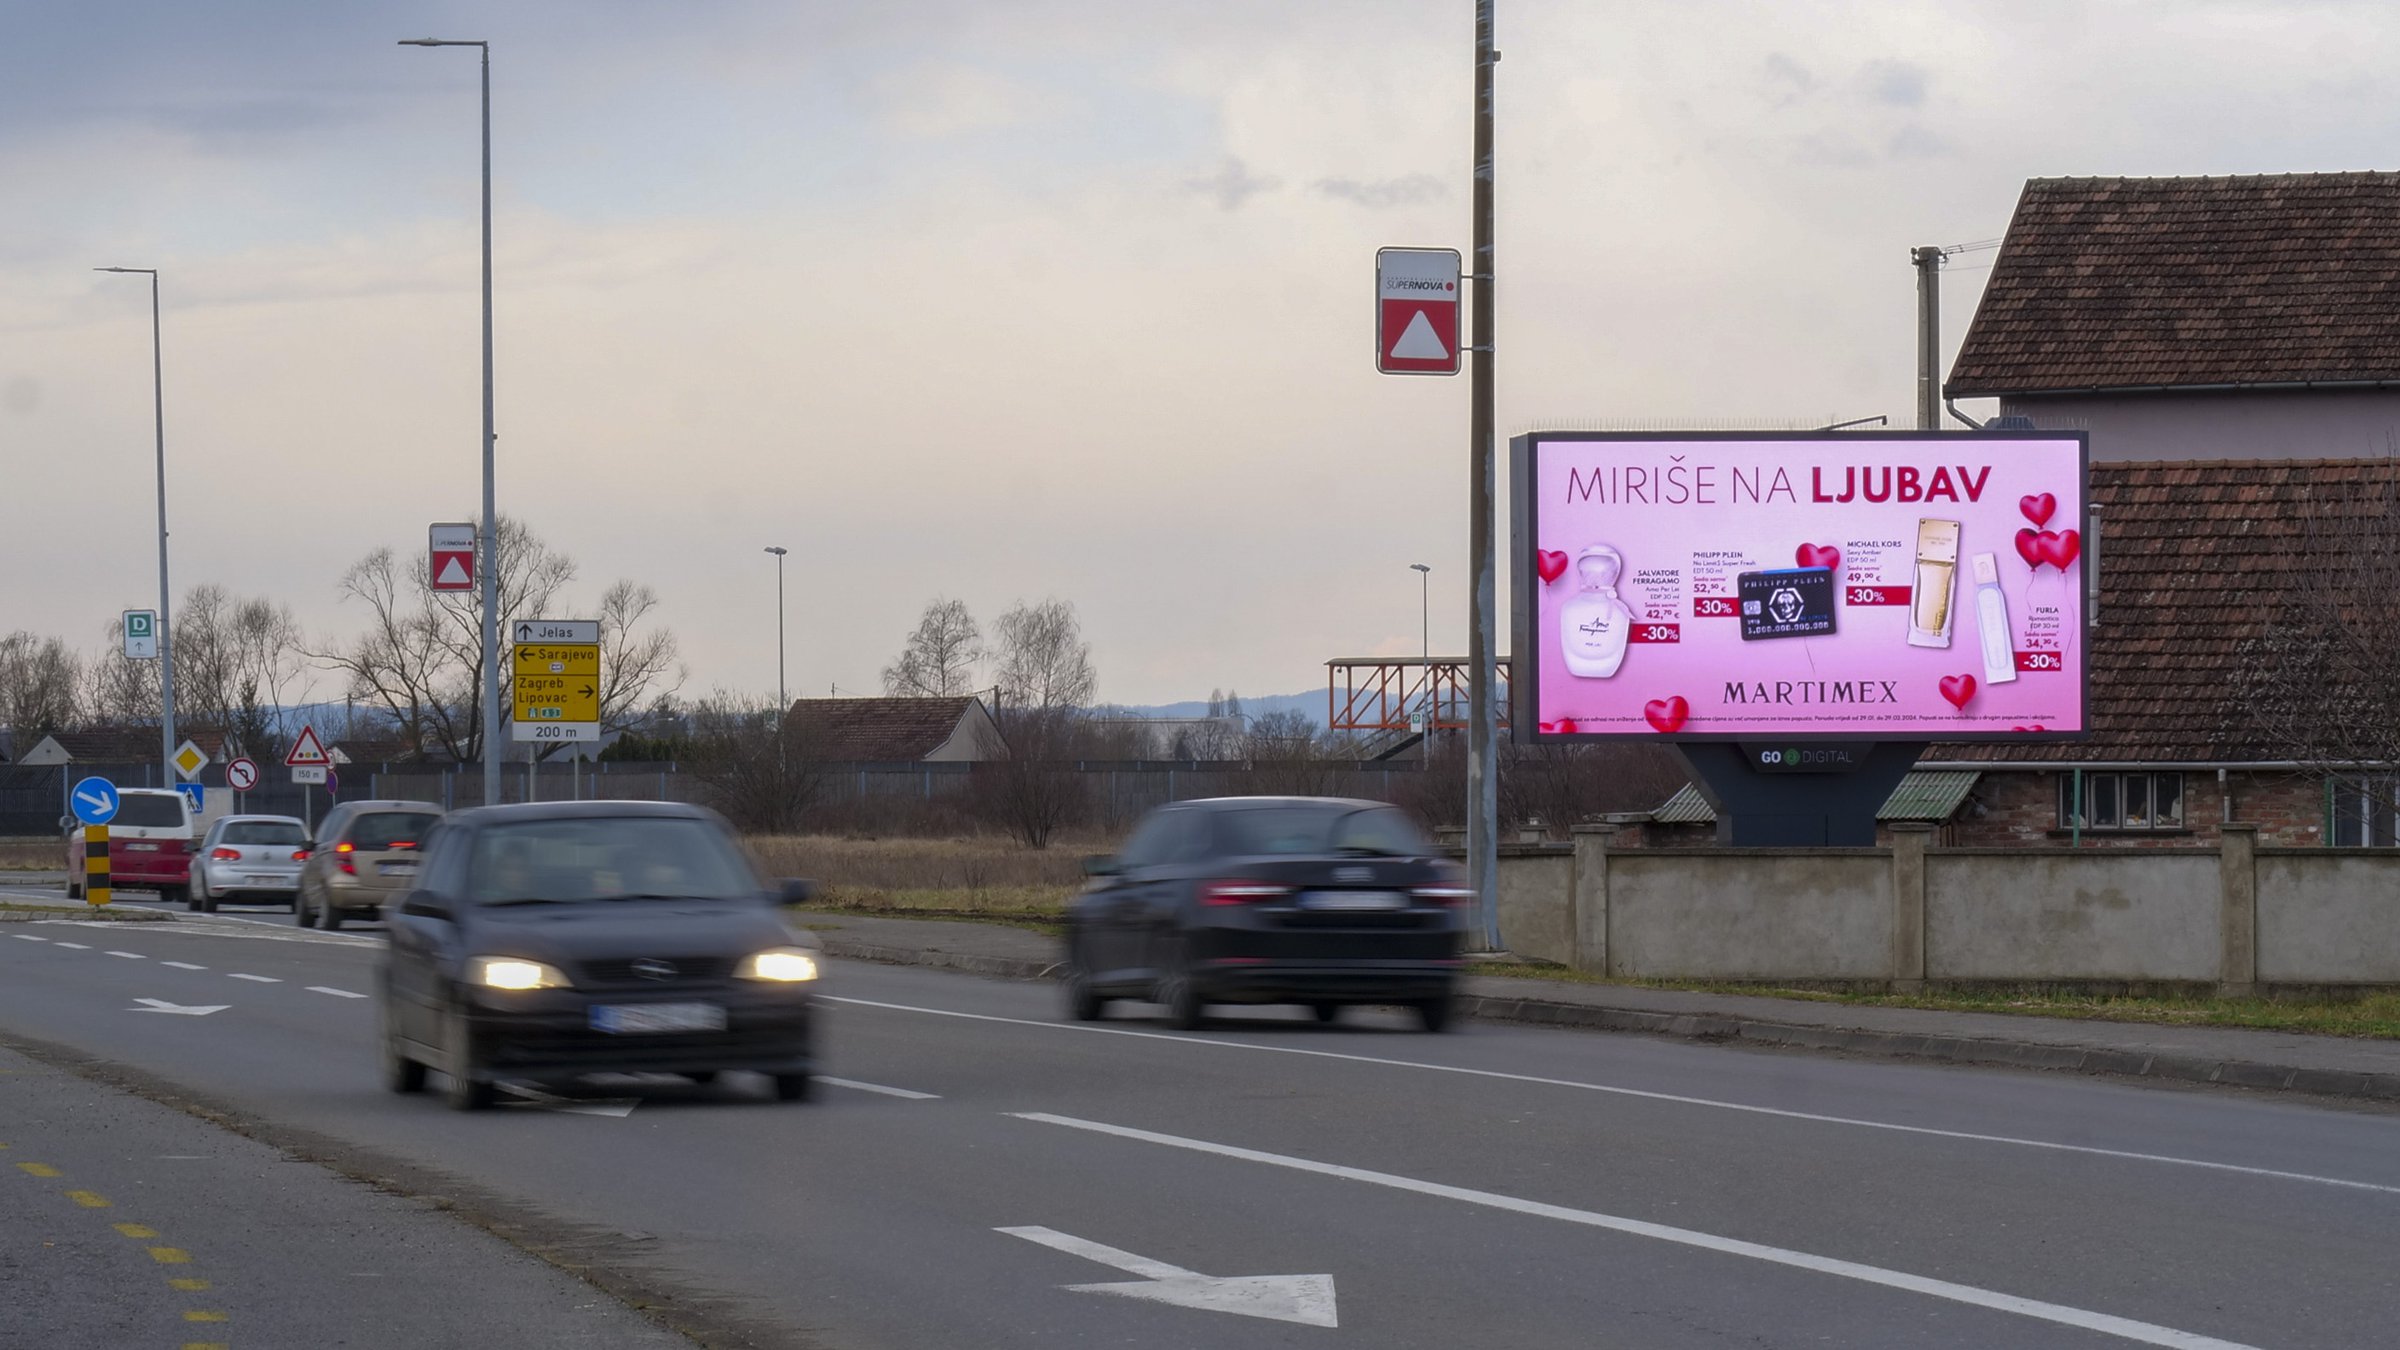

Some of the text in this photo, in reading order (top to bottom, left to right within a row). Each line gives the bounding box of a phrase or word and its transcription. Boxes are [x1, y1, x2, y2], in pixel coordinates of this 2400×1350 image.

[1387, 280, 1443, 291] SUPERNOVA
[1567, 455, 1992, 504] MIRIŠE NA LJUBAV
[1848, 588, 1885, 603] -30%
[1695, 600, 1733, 614] -30%
[1646, 609, 1672, 620] 42,70
[133, 617, 147, 631] D
[539, 627, 573, 638] Jelas
[1642, 626, 1679, 640] -30%
[538, 648, 594, 662] Sarajevo
[2023, 654, 2060, 668] -30%
[519, 677, 564, 691] Zagreb
[518, 692, 568, 705] Lipovac
[1723, 681, 1898, 705] MARTIMEX
[536, 726, 577, 738] 200 m
[1761, 750, 1781, 763] GO
[1802, 750, 1853, 763] DIGITAL
[298, 770, 311, 779] 150
